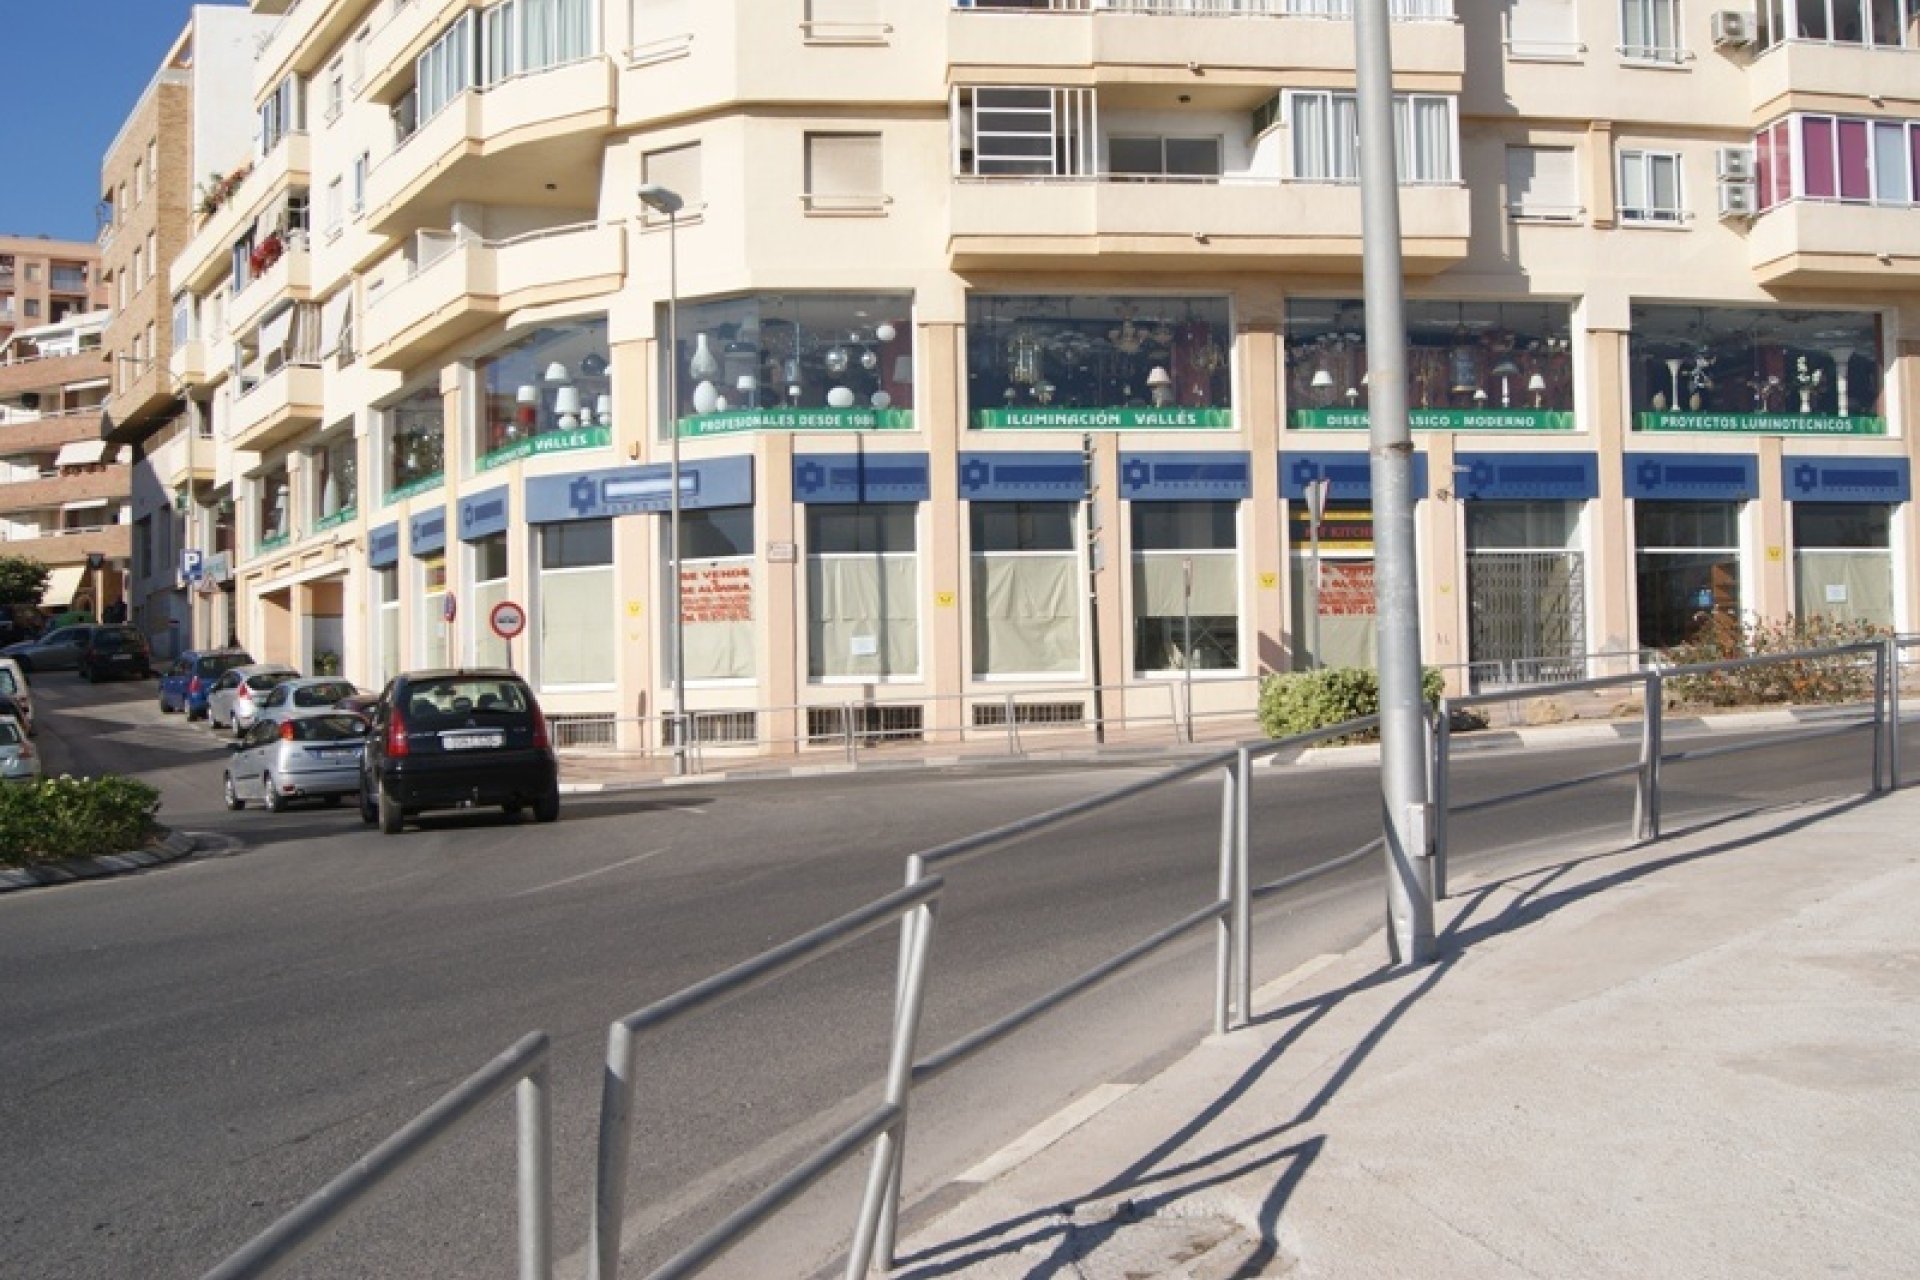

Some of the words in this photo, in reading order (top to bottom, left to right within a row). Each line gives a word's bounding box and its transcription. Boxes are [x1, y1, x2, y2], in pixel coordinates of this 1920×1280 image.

[798, 413, 840, 426] DESDE
[1007, 411, 1121, 425] ILUMINACIÓN
[1134, 411, 1196, 425] VALLÉS
[1463, 415, 1535, 427] MODERNO
[1660, 415, 1737, 430] PROYECTOS
[184, 553, 200, 572] P
